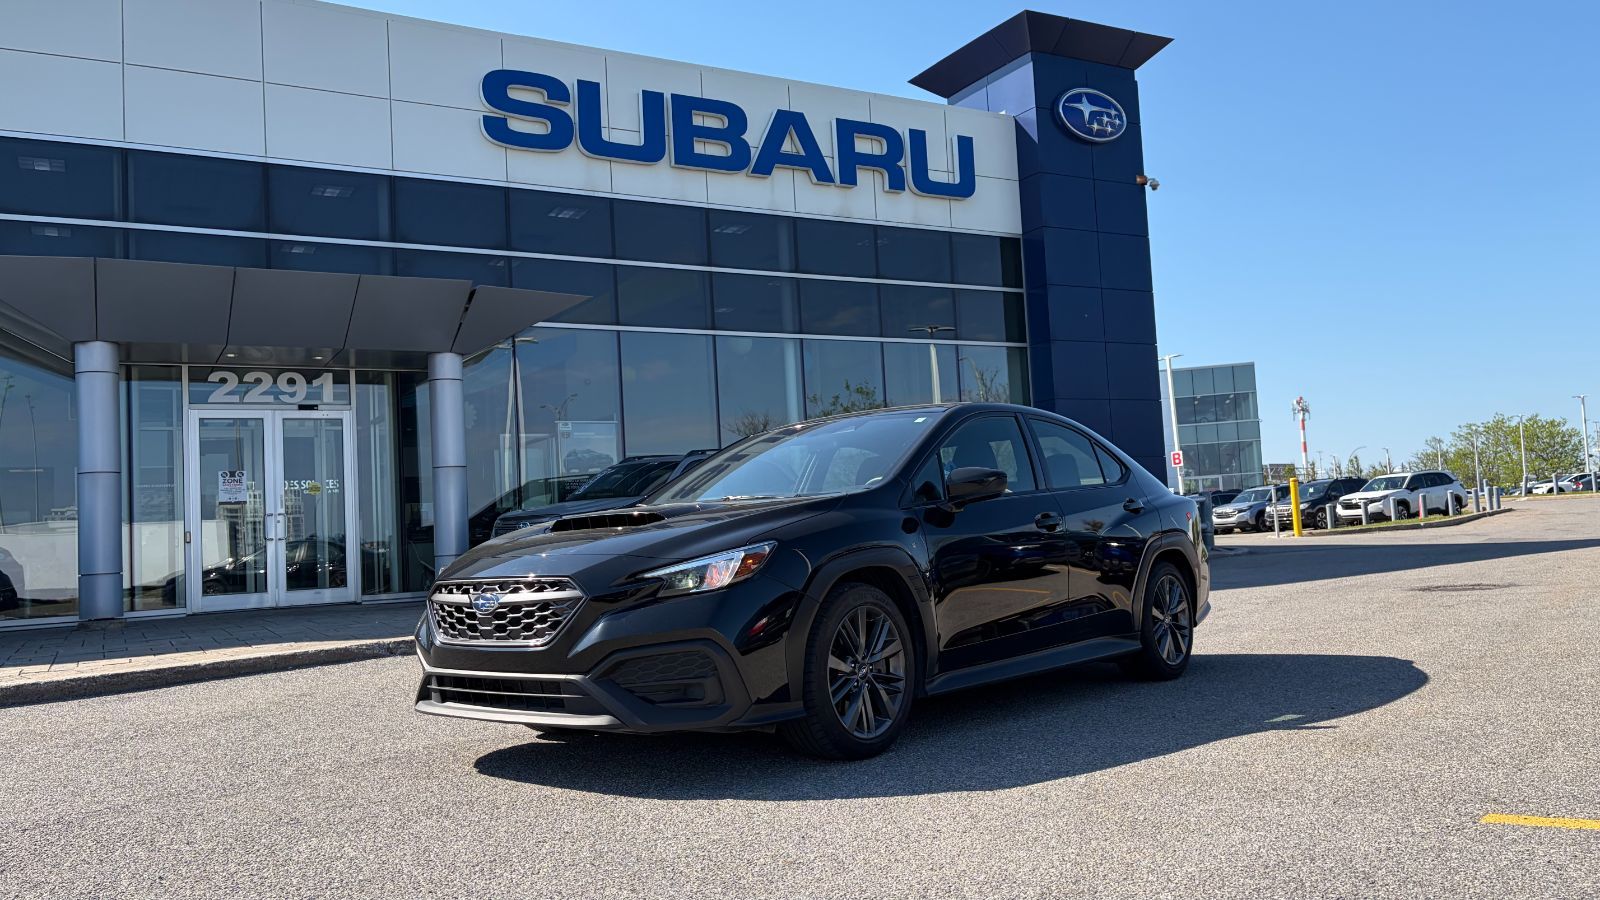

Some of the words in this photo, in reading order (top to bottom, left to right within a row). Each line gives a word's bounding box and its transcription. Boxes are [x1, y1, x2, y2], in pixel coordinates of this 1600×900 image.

[481, 69, 976, 199] SUBARU
[207, 371, 334, 403] 2291
[1172, 452, 1182, 465] B
